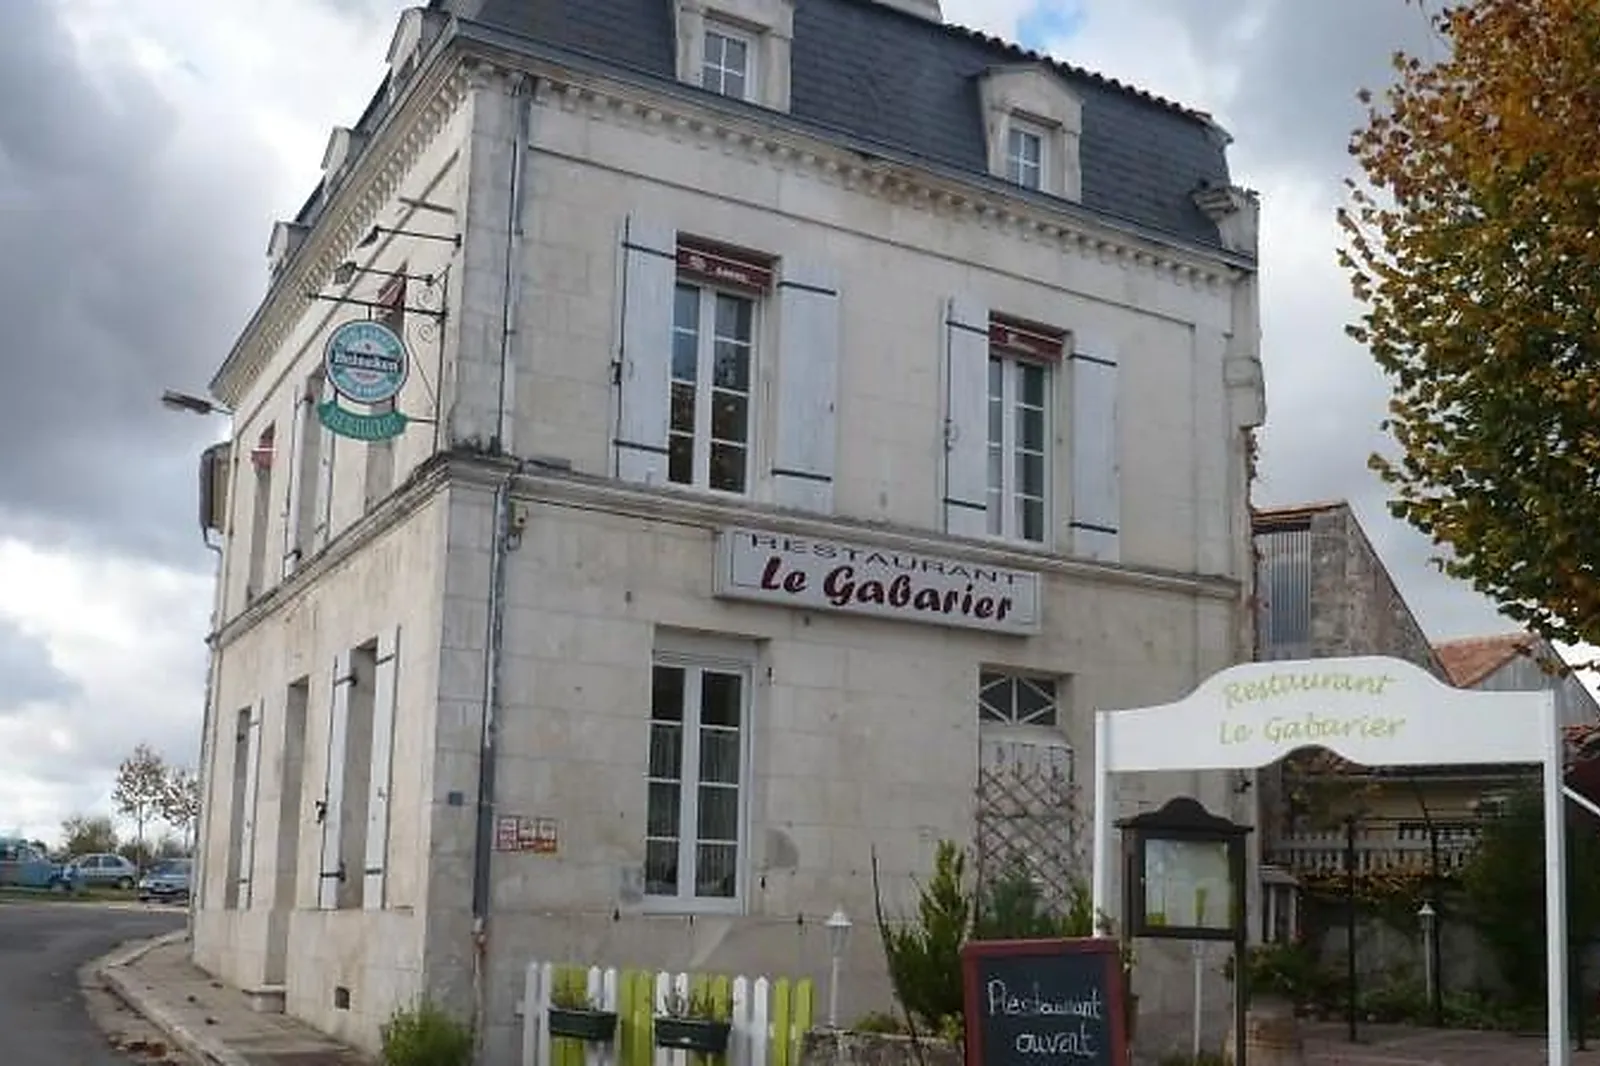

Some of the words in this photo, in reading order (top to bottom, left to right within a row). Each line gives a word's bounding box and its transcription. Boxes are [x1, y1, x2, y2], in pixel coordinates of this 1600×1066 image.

[751, 533, 1021, 585] RESTAURANT
[761, 556, 807, 592] Le
[824, 565, 1012, 621] Gabarier
[1224, 672, 1397, 708] Restaurant
[1220, 720, 1251, 744] Le
[1264, 712, 1405, 744] Gabarier
